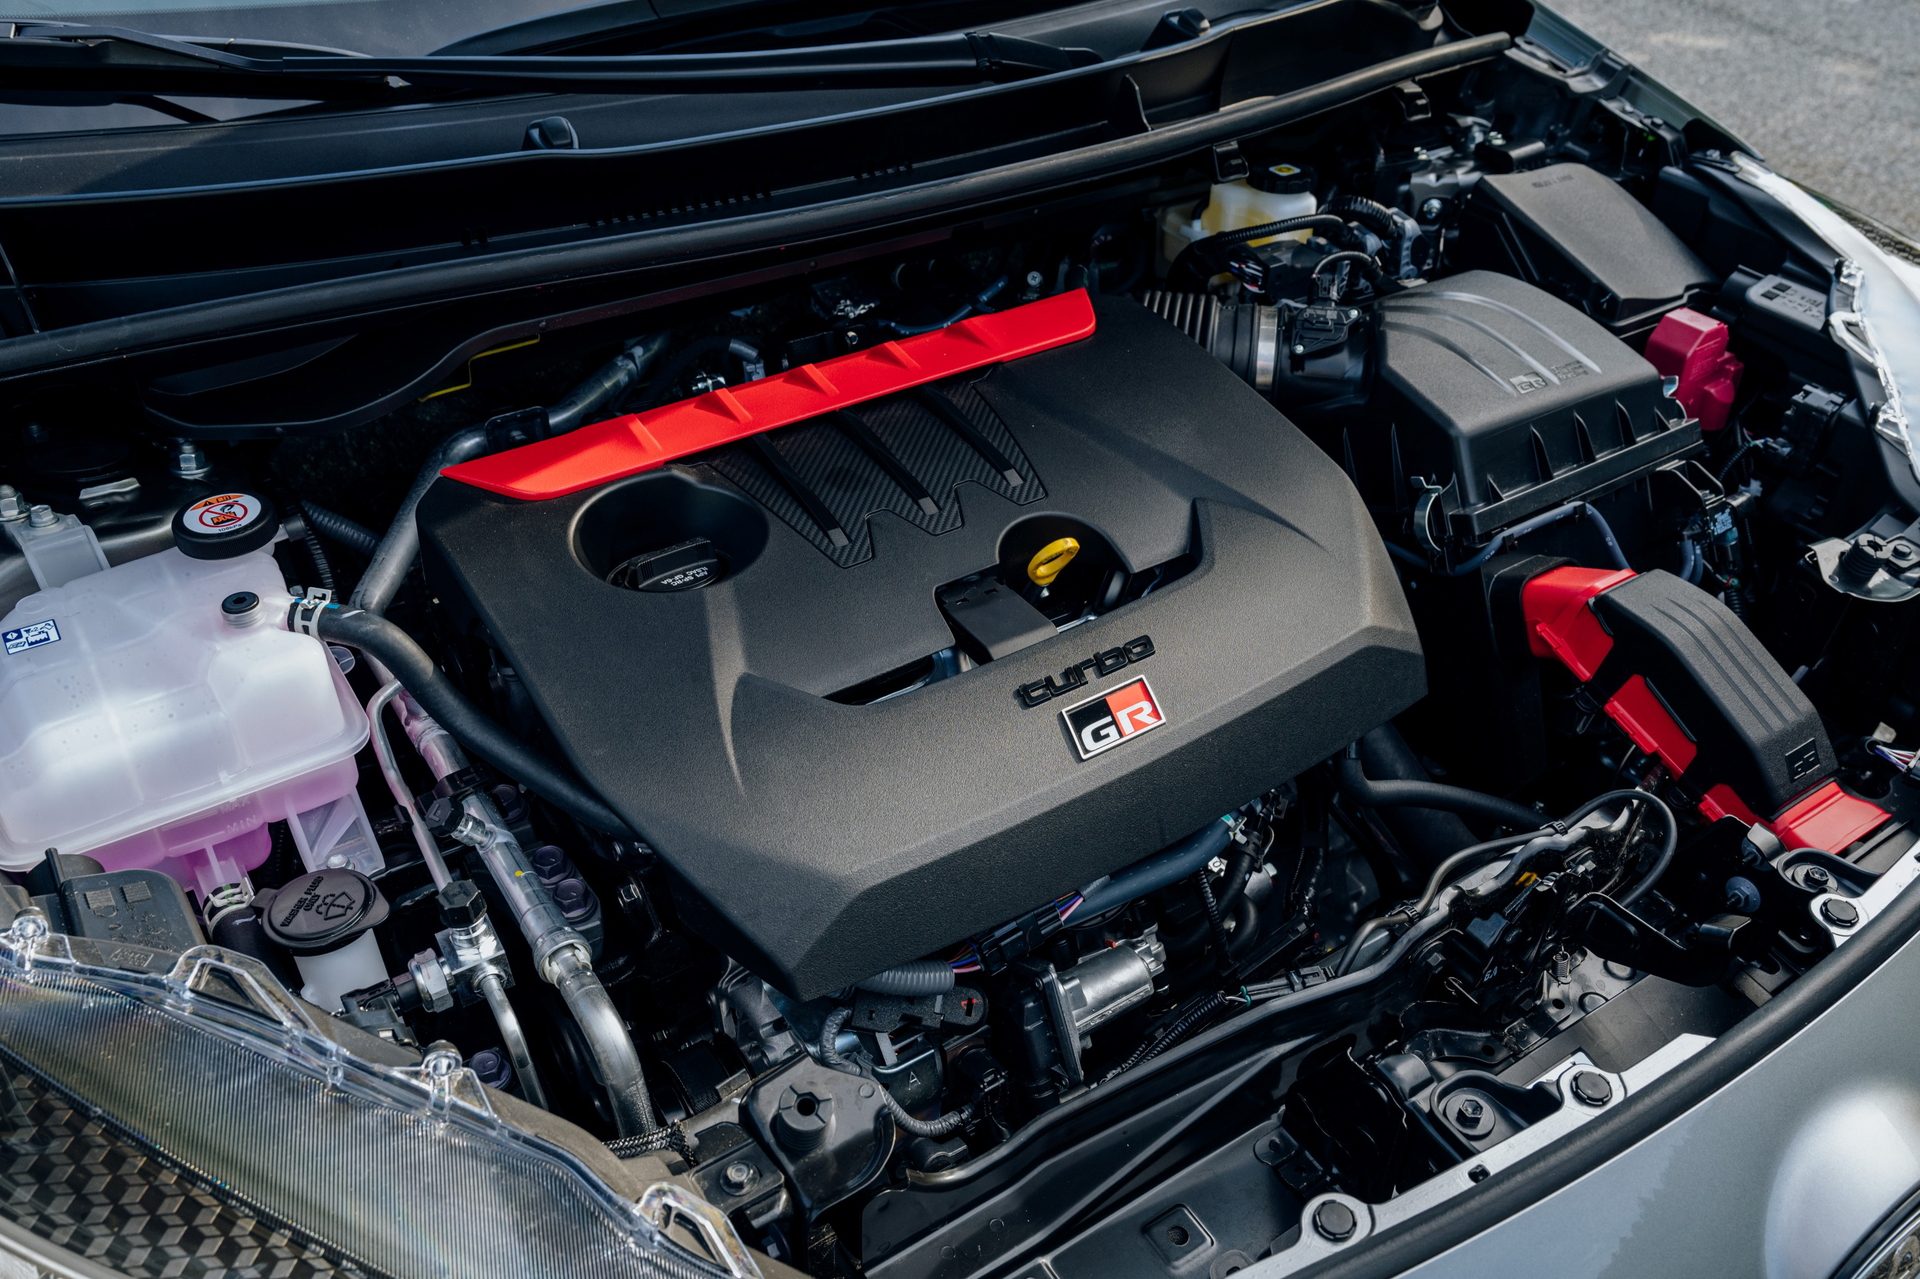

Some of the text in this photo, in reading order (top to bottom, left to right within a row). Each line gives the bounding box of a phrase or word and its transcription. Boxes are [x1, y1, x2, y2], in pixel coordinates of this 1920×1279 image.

[1517, 379, 1546, 392] GR
[685, 566, 709, 577] ILSAC
[1018, 635, 1156, 707] turbo
[1081, 700, 1160, 752] GR
[227, 815, 258, 834] MIN
[280, 876, 324, 927] WASHER FLUID
[303, 893, 321, 911] ONLY
